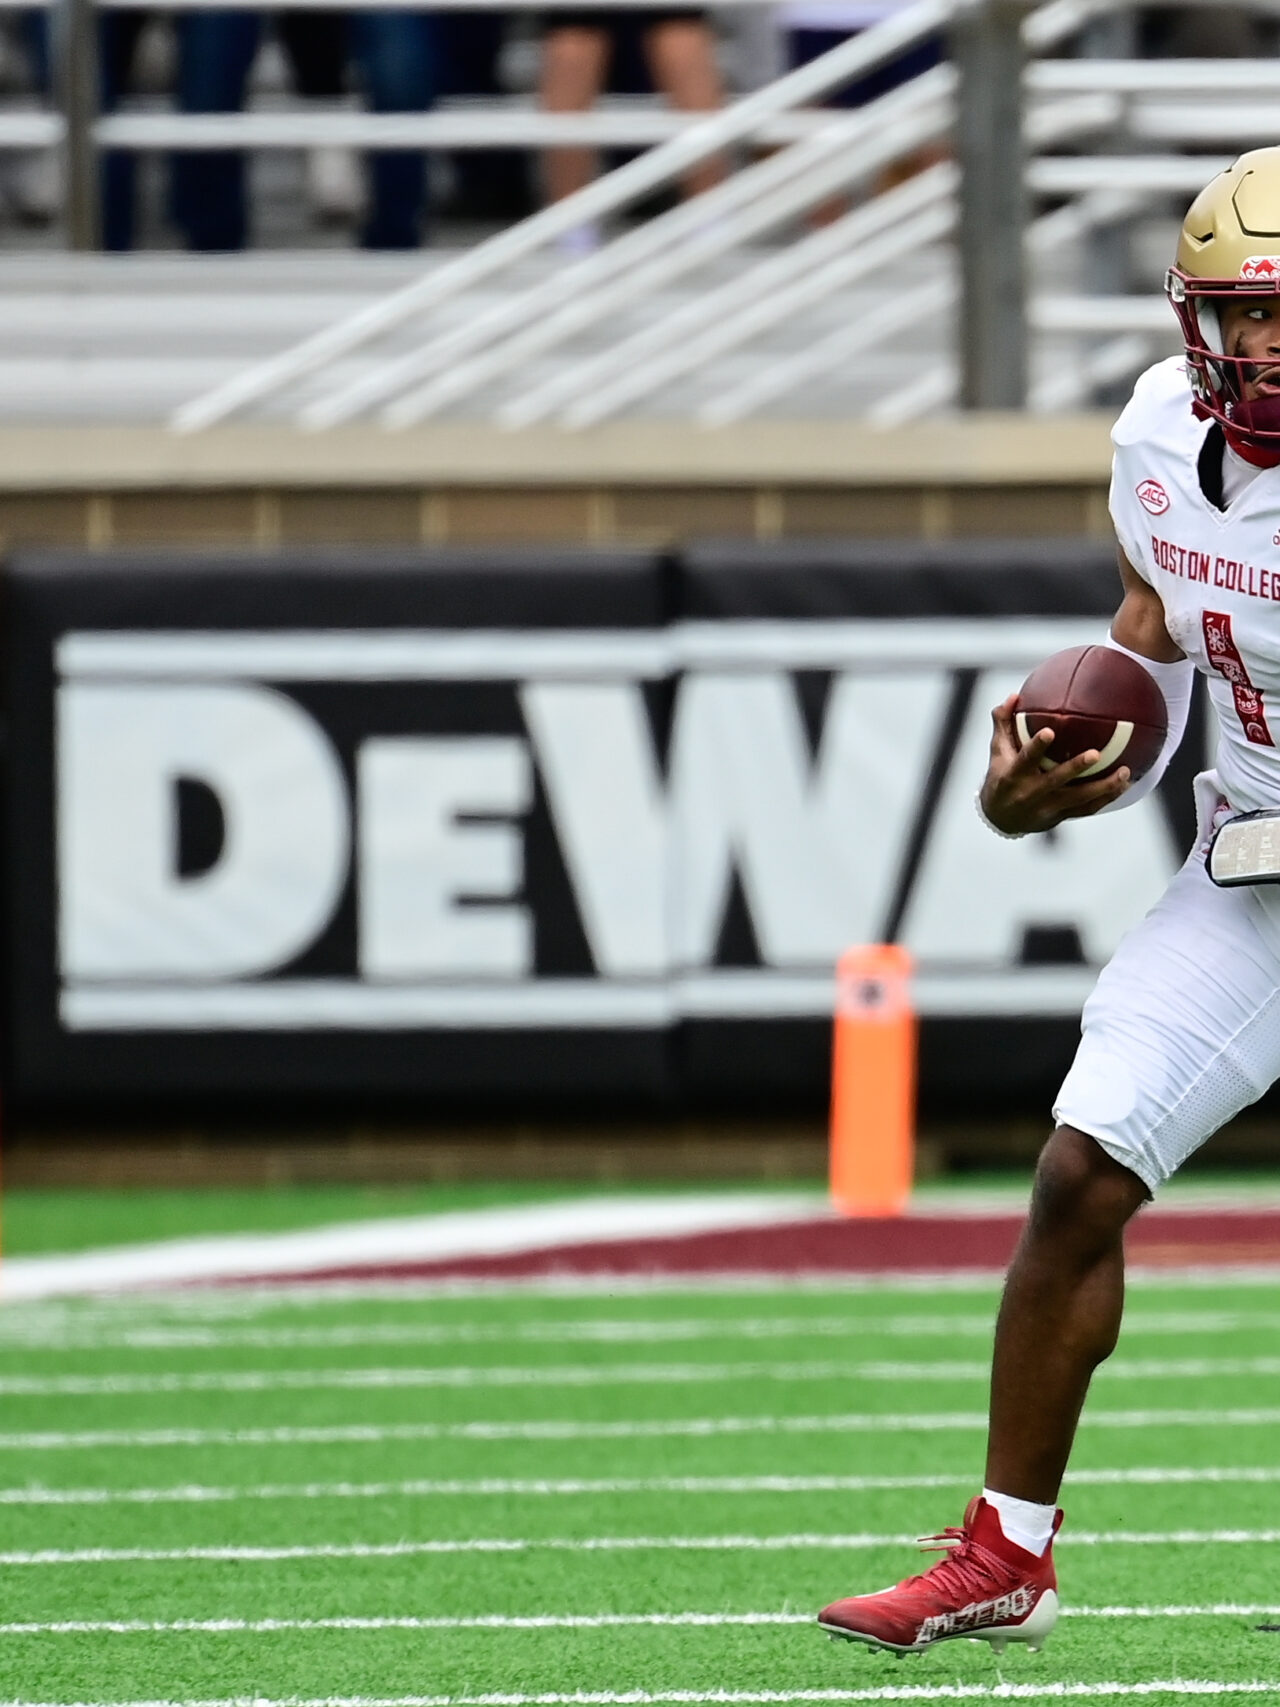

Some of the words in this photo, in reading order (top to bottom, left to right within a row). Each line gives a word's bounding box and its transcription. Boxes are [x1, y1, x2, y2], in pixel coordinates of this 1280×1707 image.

[1142, 487, 1166, 505] ACC
[1152, 535, 1210, 585] BOSTON
[1201, 609, 1277, 747] 1
